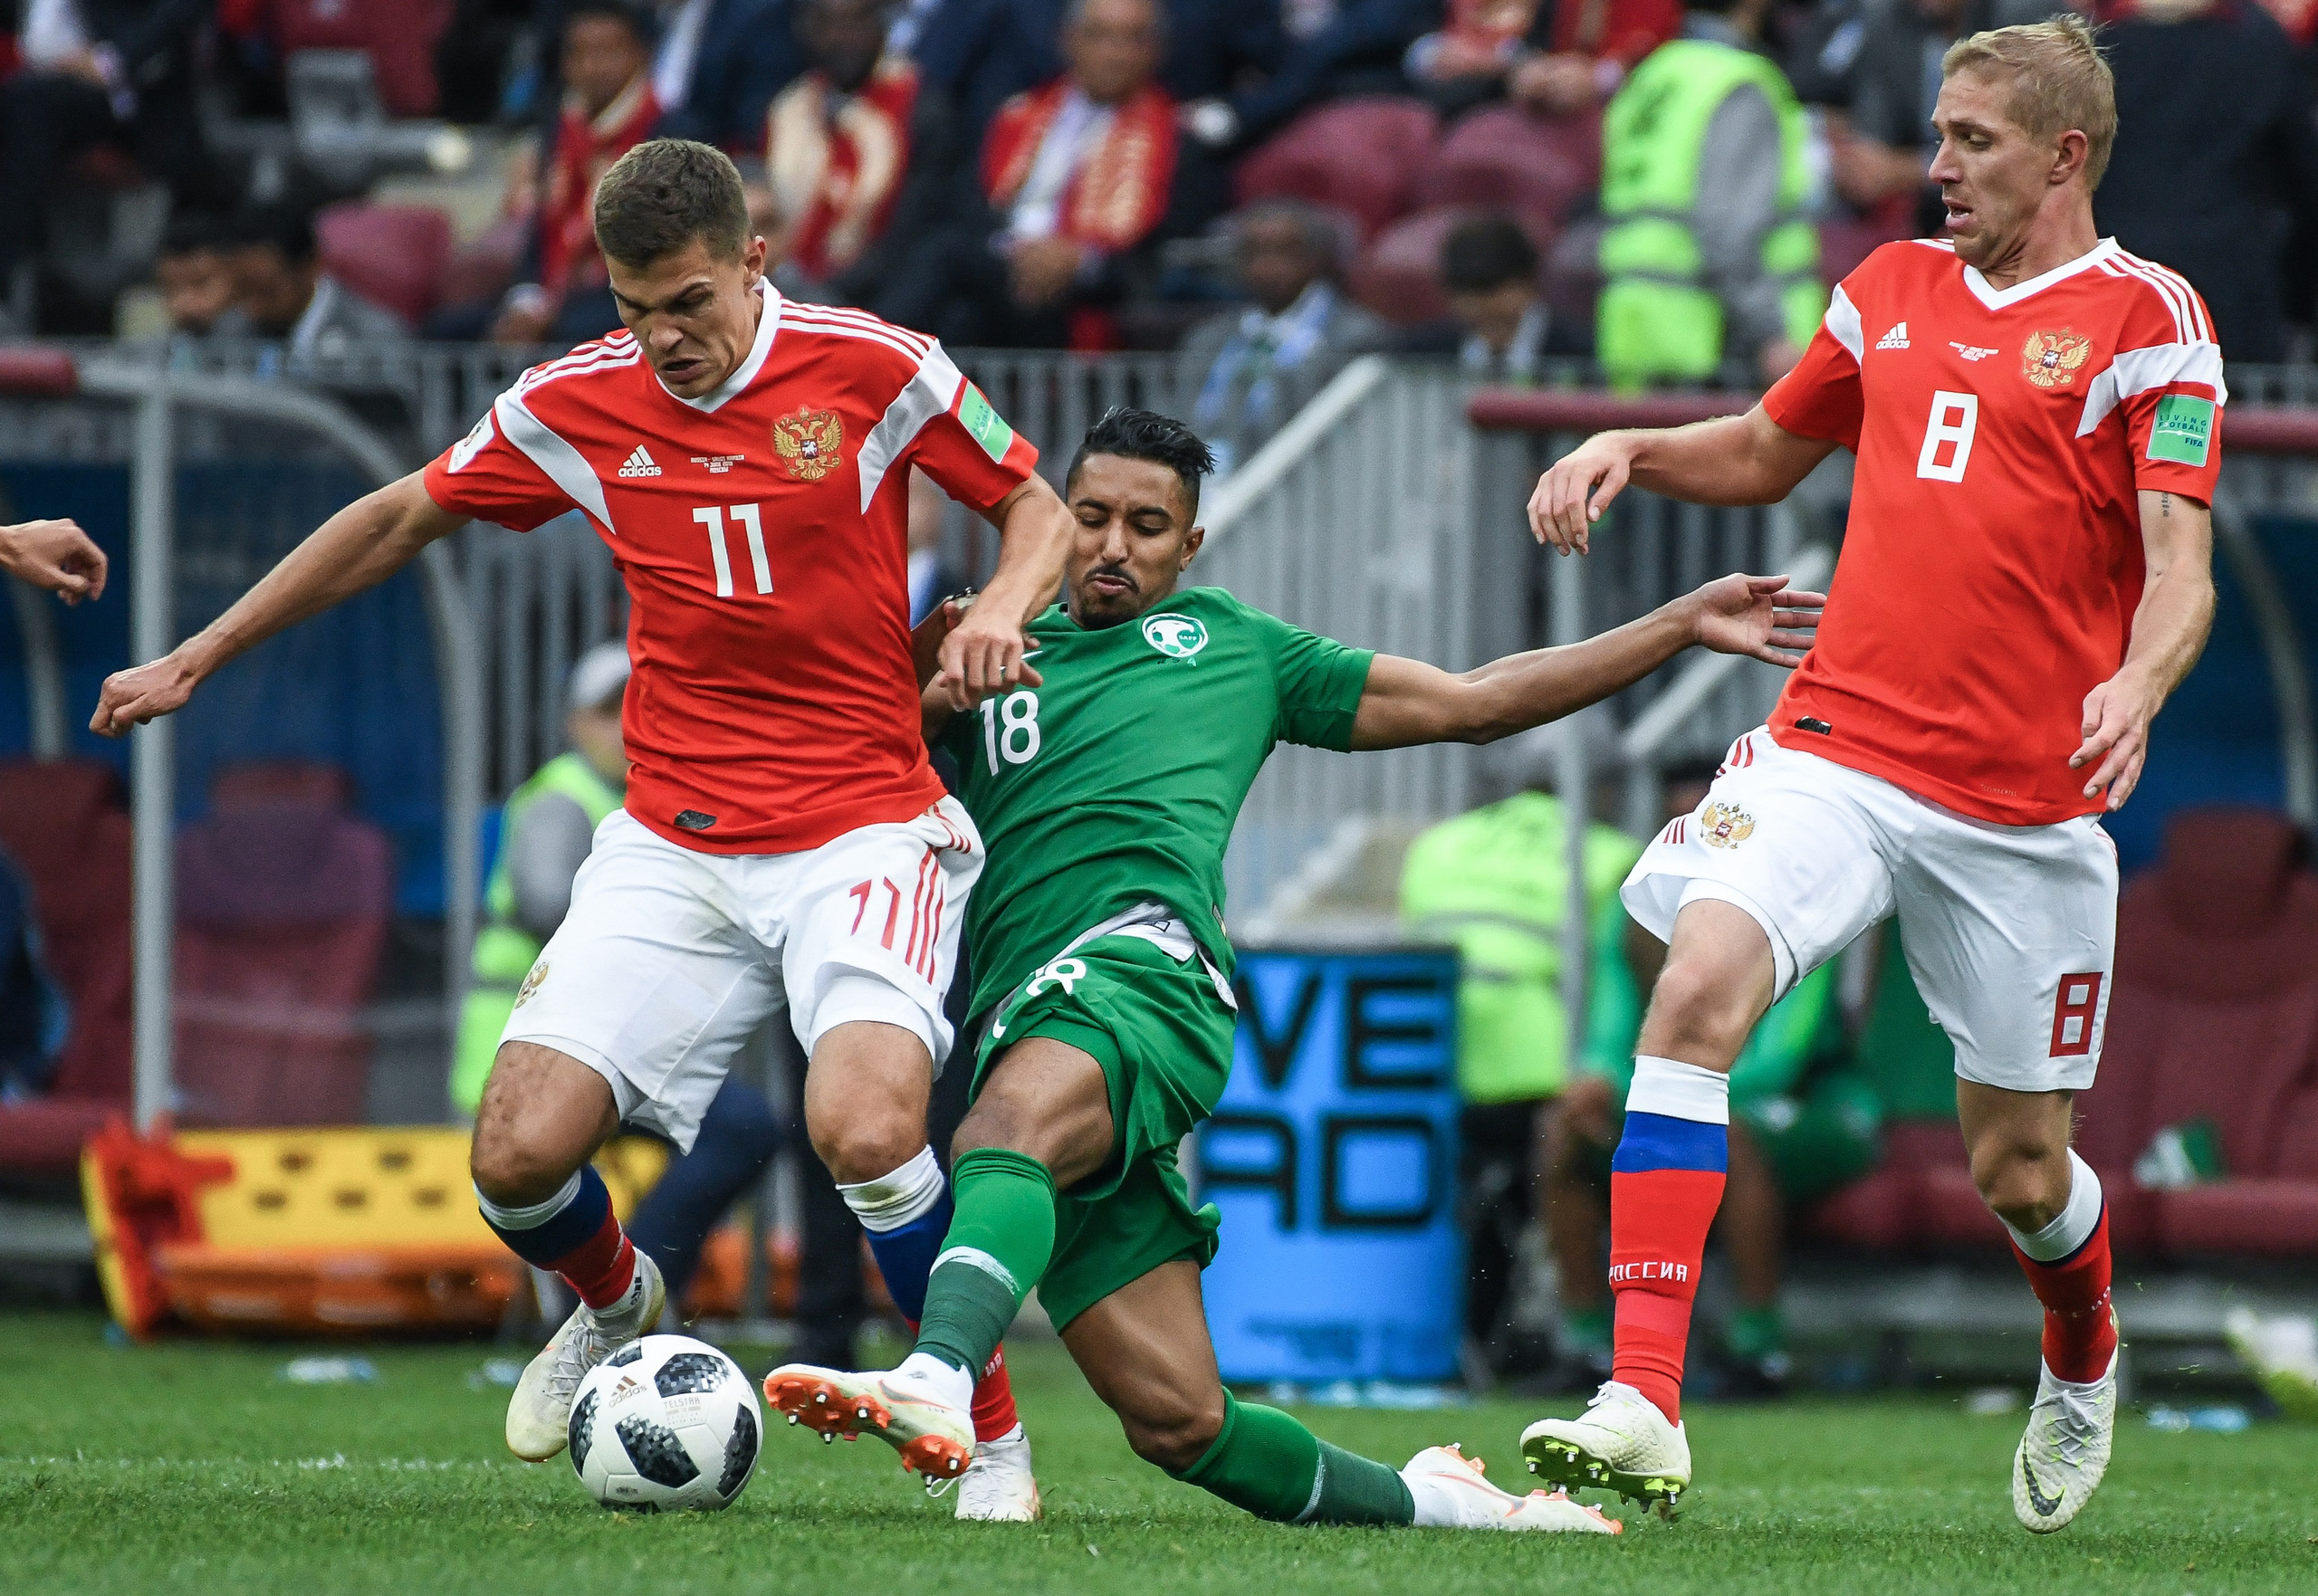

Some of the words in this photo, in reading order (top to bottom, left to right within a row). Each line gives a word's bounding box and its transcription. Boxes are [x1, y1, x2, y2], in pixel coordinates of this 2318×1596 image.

[1875, 339, 1911, 350] adidas
[2160, 415, 2207, 426] LIVING
[1916, 389, 1978, 483] 8
[2184, 437, 2203, 447] FIFA
[618, 465, 663, 478] adidas
[693, 503, 773, 597] 11
[980, 691, 1040, 777] 18
[849, 876, 900, 951] 11
[2049, 971, 2103, 1058] 8
[1609, 1262, 1688, 1285] РОССИЯ
[608, 1385, 647, 1408] adidas
